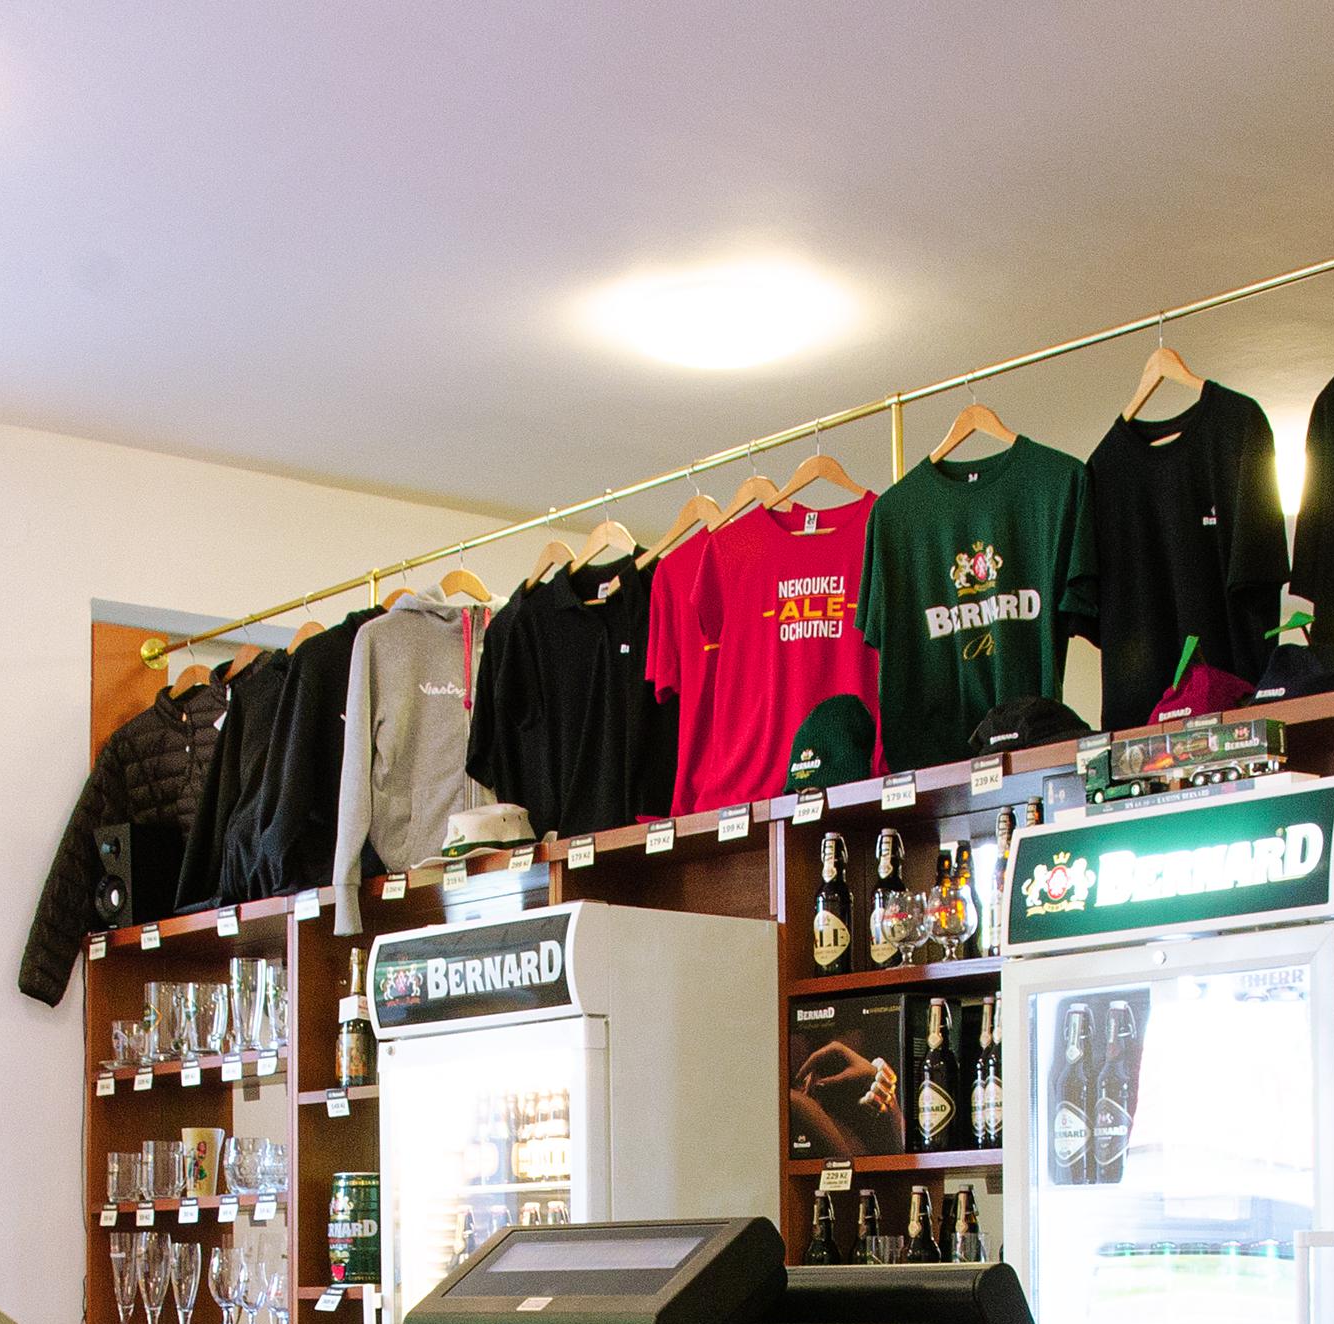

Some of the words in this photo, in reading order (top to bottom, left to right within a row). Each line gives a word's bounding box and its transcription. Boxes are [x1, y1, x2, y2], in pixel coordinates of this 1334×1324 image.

[925, 589, 1042, 640] BERNARD
[779, 620, 844, 642] OCHUTNEJ
[973, 775, 988, 788] 239
[988, 772, 1000, 785] Kč
[886, 793, 901, 803] 179
[901, 790, 913, 800] Kč
[1095, 822, 1326, 908] BERNARD
[427, 940, 563, 1000] BERNARD
[797, 1006, 835, 1022] BERNARD
